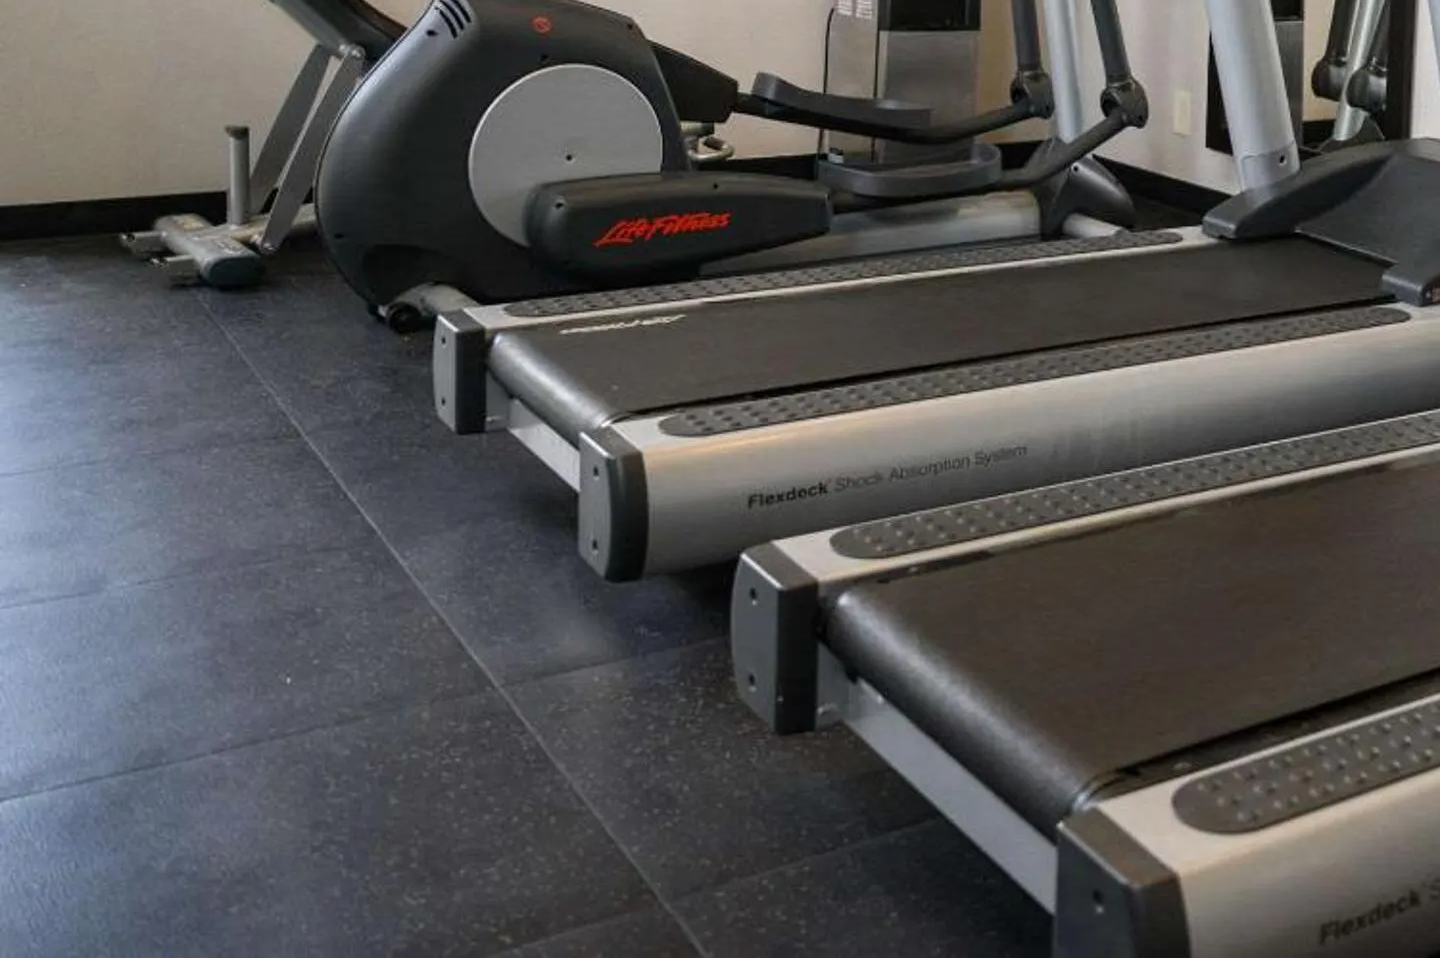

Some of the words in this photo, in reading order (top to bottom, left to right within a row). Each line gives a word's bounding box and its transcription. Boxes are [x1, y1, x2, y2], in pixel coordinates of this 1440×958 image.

[888, 455, 971, 483] Absorption
[974, 444, 1029, 469] System
[1317, 889, 1422, 945] Flexdeck
